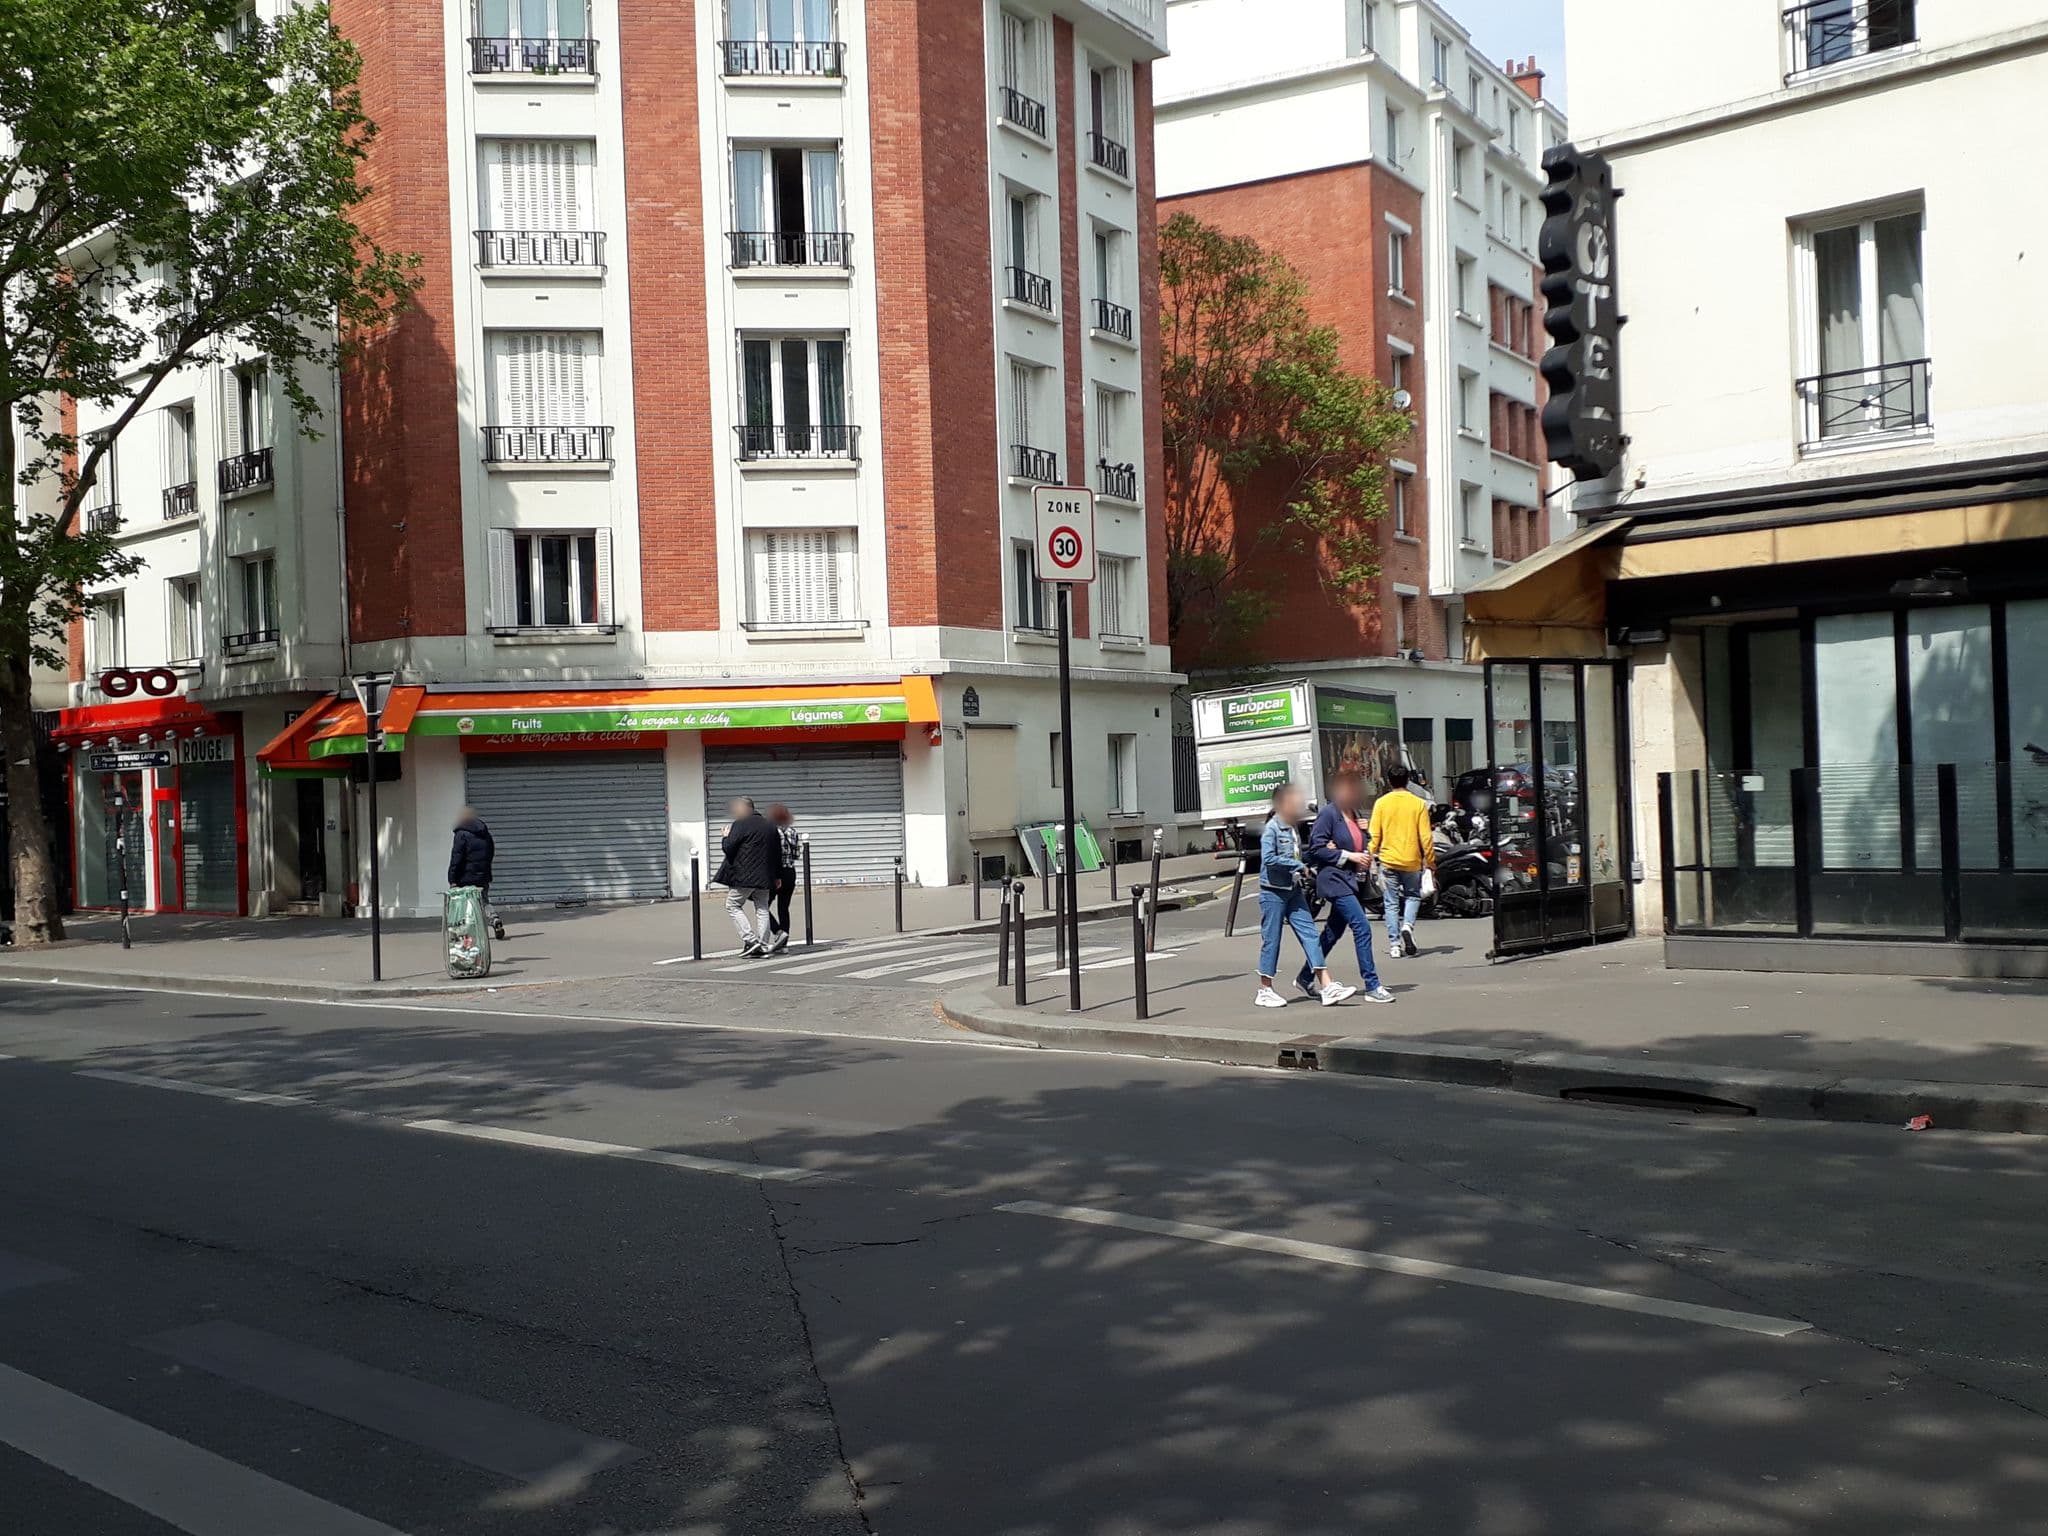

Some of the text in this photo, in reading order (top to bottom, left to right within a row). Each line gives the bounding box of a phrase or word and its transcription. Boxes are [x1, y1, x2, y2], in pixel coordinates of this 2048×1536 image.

[1047, 501, 1081, 514] ZONE
[1055, 538, 1076, 556] 30
[1228, 698, 1286, 715] Europcar
[616, 711, 731, 729] Les vergers de clichy
[791, 710, 844, 722] Légumes
[511, 718, 542, 730] Fruits
[1229, 719, 1255, 727] moving
[183, 738, 223, 763] ROUGE
[1227, 770, 1285, 782] Plus pratique
[1229, 785, 1250, 794] avec
